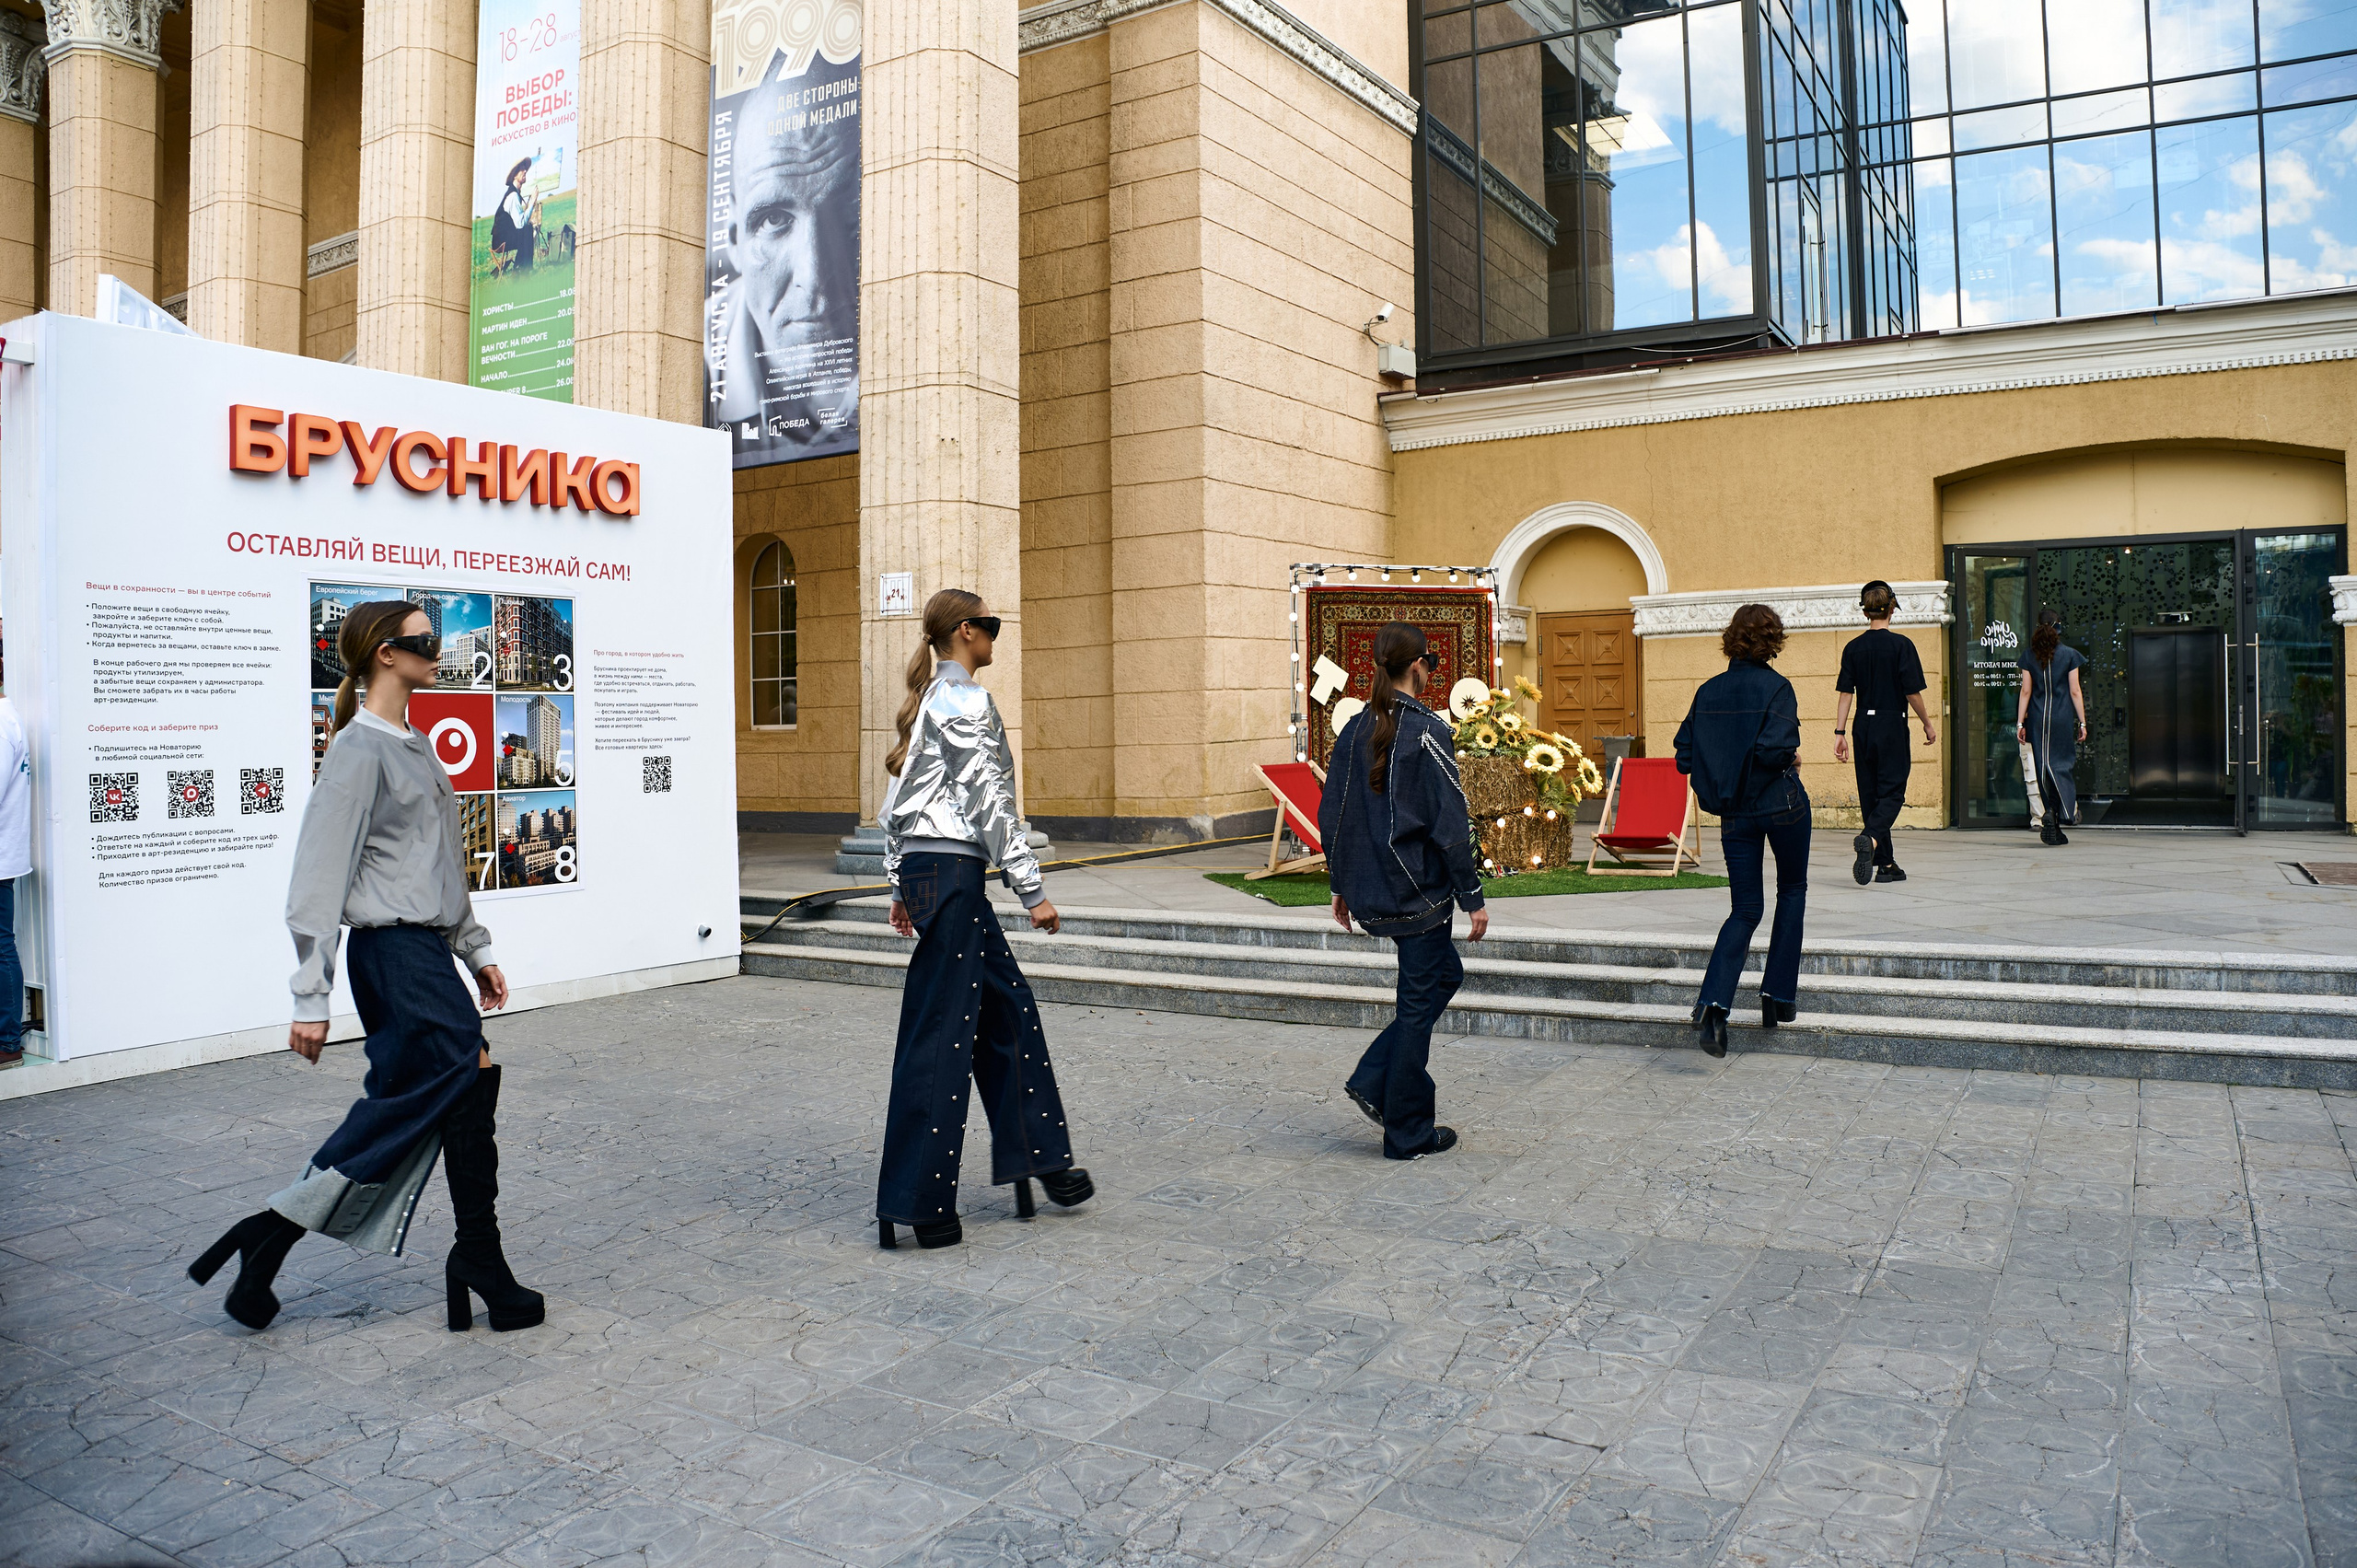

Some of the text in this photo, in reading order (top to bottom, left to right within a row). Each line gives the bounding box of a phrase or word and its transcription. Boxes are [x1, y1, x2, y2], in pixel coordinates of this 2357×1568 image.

[499, 13, 557, 64] 18-28
[506, 69, 565, 104] ВЫБОР
[777, 76, 858, 113] ДВЕ СТОРОНЫ
[497, 89, 572, 129] ПОБЕДЫ:
[767, 99, 857, 136] ОДНОЙ МЕДАЛИ
[491, 111, 576, 147] ИСКУССТВО В КИНО
[713, 110, 732, 223] СЕНТЯБРЯ
[712, 228, 729, 252] 19
[483, 302, 514, 317] ХОРИСТЫ
[482, 322, 508, 335] МАРТИН
[509, 318, 527, 329] ИДЕН
[711, 274, 729, 371] АВГУСТА
[481, 332, 548, 354] ВАН ГОГ. НА ПОРОГЕ
[481, 350, 516, 365] ВЕЧНОСТИ
[481, 371, 508, 383] НАЧАЛО
[710, 380, 727, 402] 21
[779, 418, 810, 429] ПОБЕДА
[227, 531, 631, 582] ОСТАВЛЯЙ ВЕЩИ, ПЕРЕЕЗЖАЙ САМ!
[86, 582, 111, 591] Вещи
[120, 585, 175, 593] сохранности
[316, 586, 359, 596] Европейский
[891, 588, 900, 598] 21
[91, 603, 131, 611] Положите
[161, 606, 203, 615] свободную
[204, 608, 230, 616] ячейку,
[137, 614, 172, 622] заберите
[91, 622, 141, 630] Пожалуйста,
[470, 652, 492, 690] 2
[553, 654, 573, 691] 3
[87, 724, 131, 733] Соберите
[158, 723, 197, 732] заберите
[555, 750, 574, 787] 5
[96, 834, 140, 843] Дождитесь
[142, 831, 187, 840] публикации
[97, 852, 139, 861] Приходите
[147, 847, 209, 857] арт-резиденцию
[217, 844, 253, 852] забирайте
[555, 845, 577, 882] 8
[99, 873, 219, 888] Количество призов ограничено.
[474, 851, 495, 890] 7
